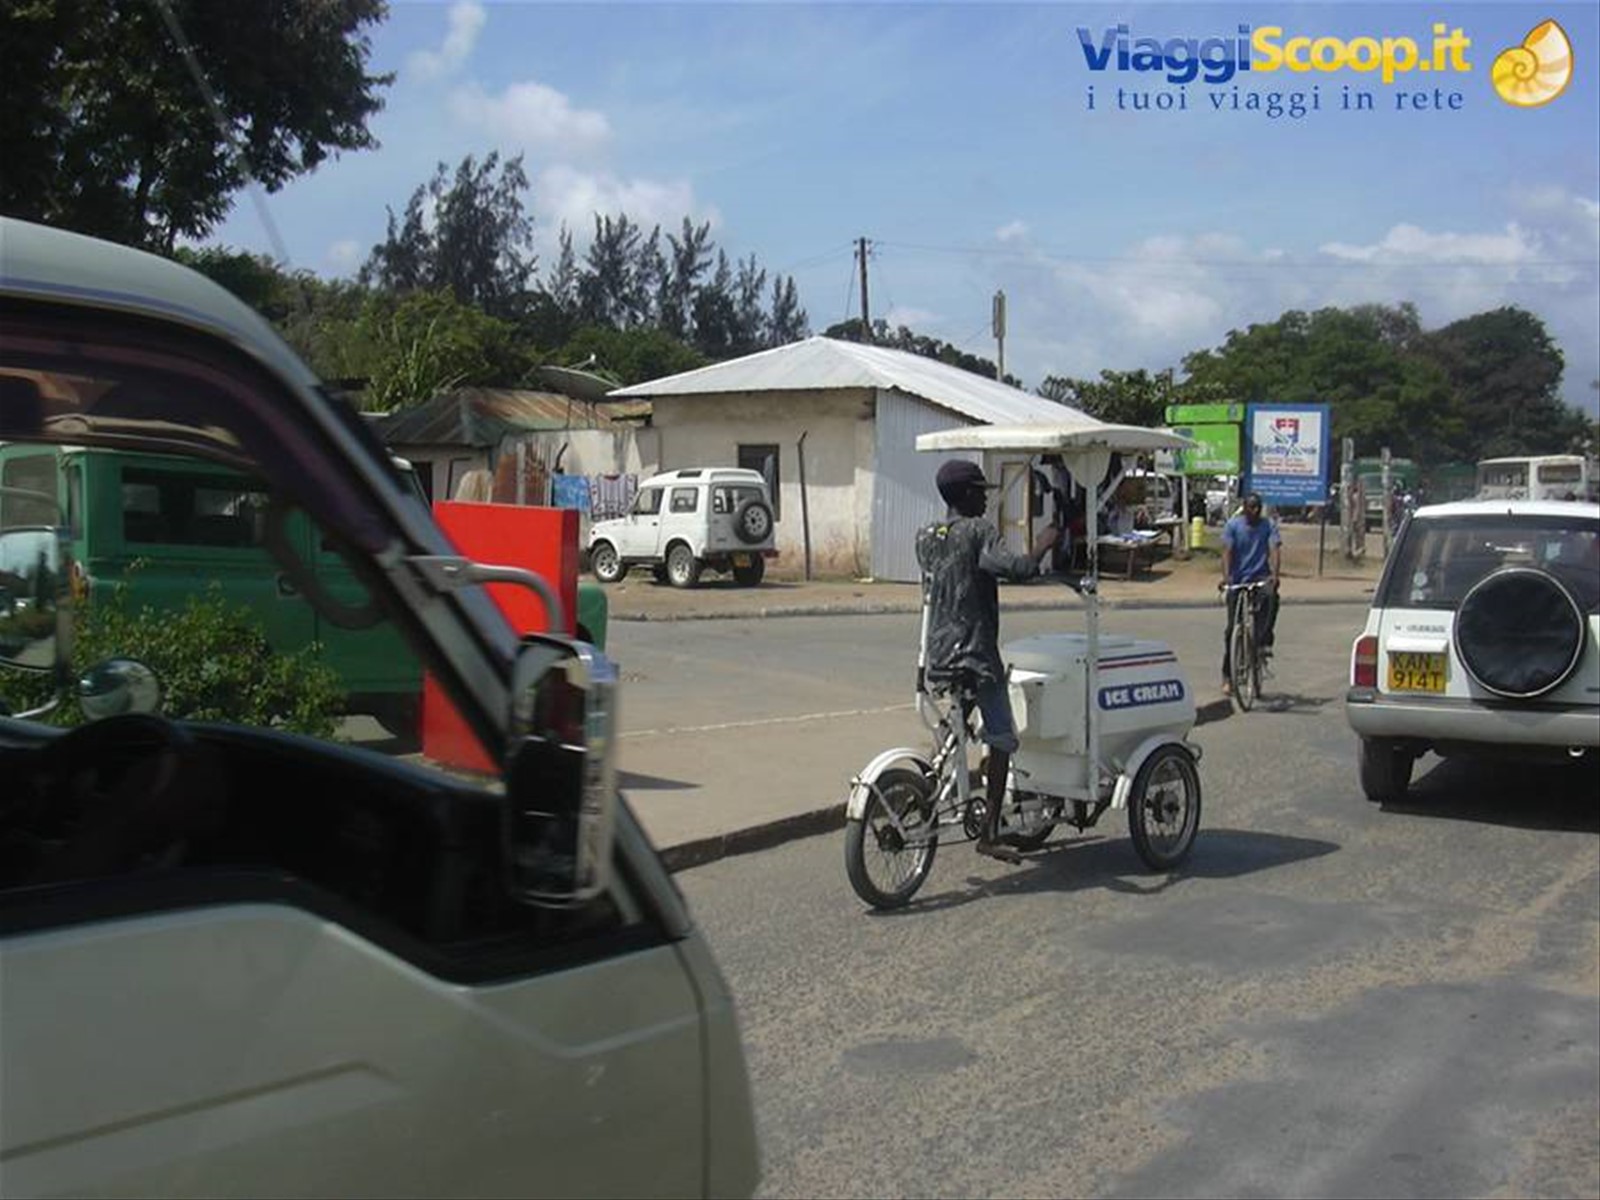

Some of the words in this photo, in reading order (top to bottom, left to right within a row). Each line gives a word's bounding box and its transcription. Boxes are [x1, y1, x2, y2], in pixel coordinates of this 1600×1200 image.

[1393, 670, 1443, 689] 914T
[1104, 688, 1131, 707] ICE
[1132, 683, 1180, 703] CREAM
